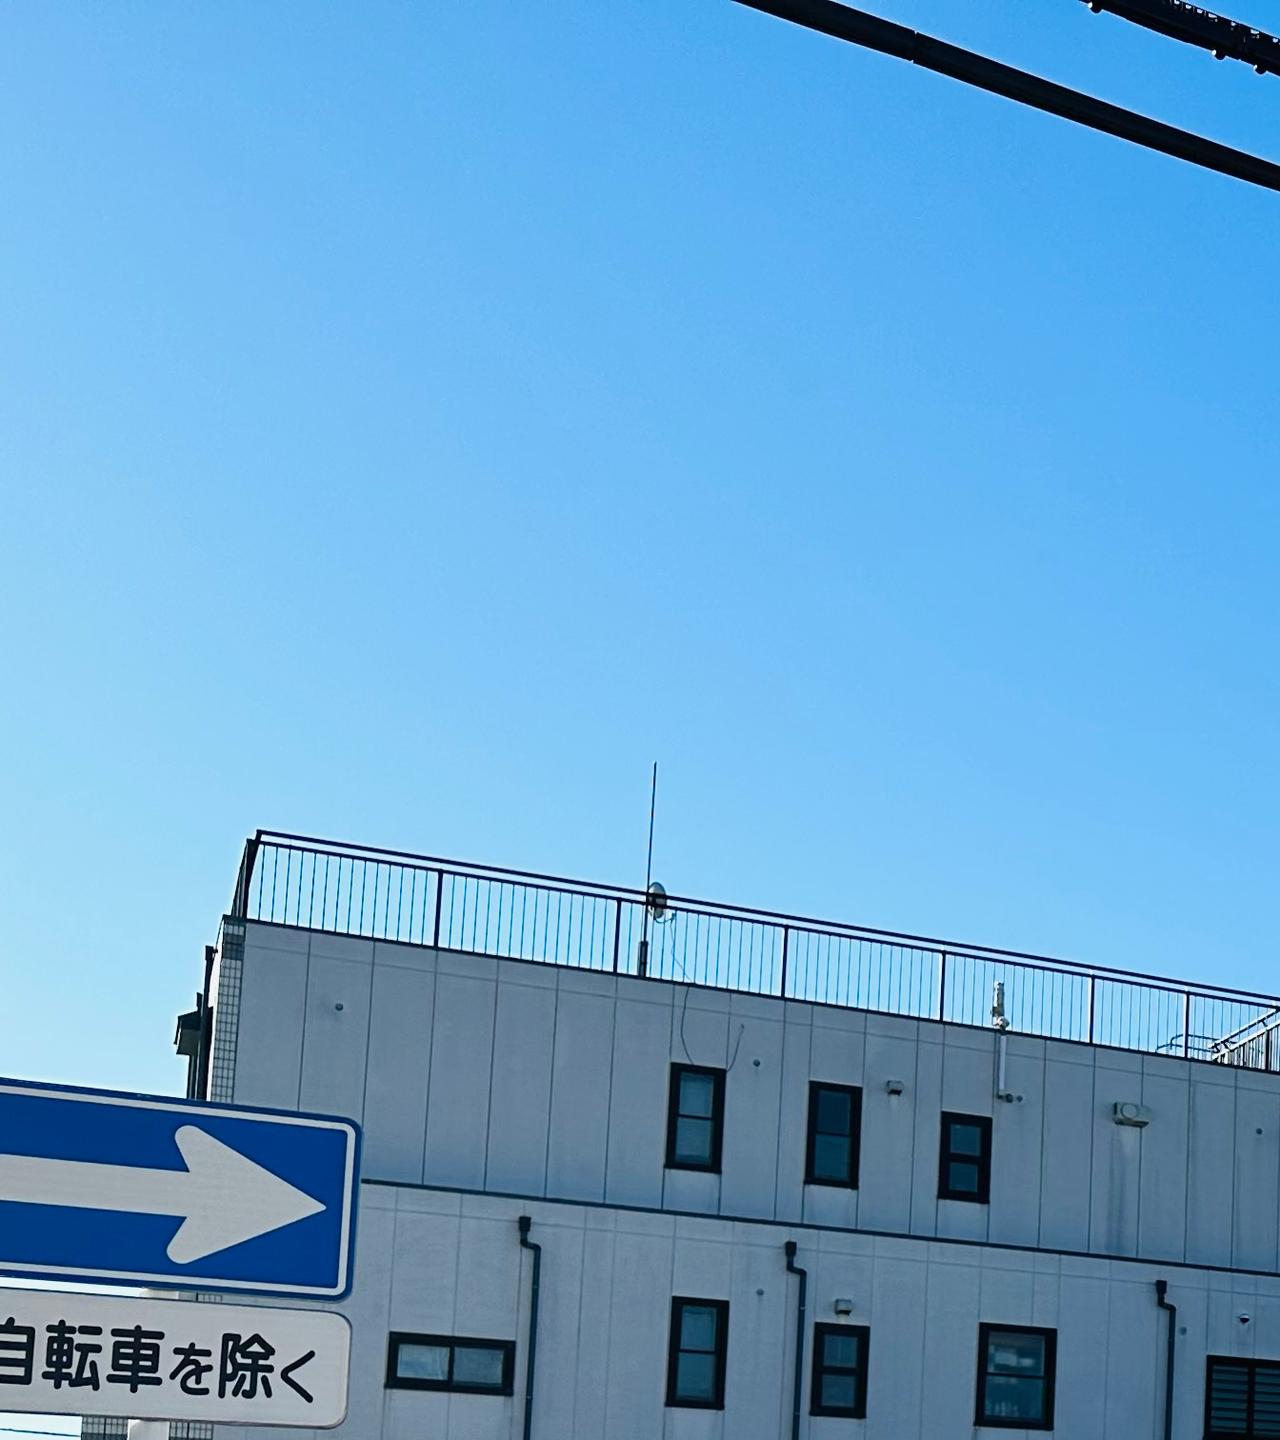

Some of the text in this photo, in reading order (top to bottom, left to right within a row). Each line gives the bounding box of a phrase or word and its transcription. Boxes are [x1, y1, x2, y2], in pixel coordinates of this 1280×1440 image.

[0, 1317, 316, 1404] 自転車を除く
